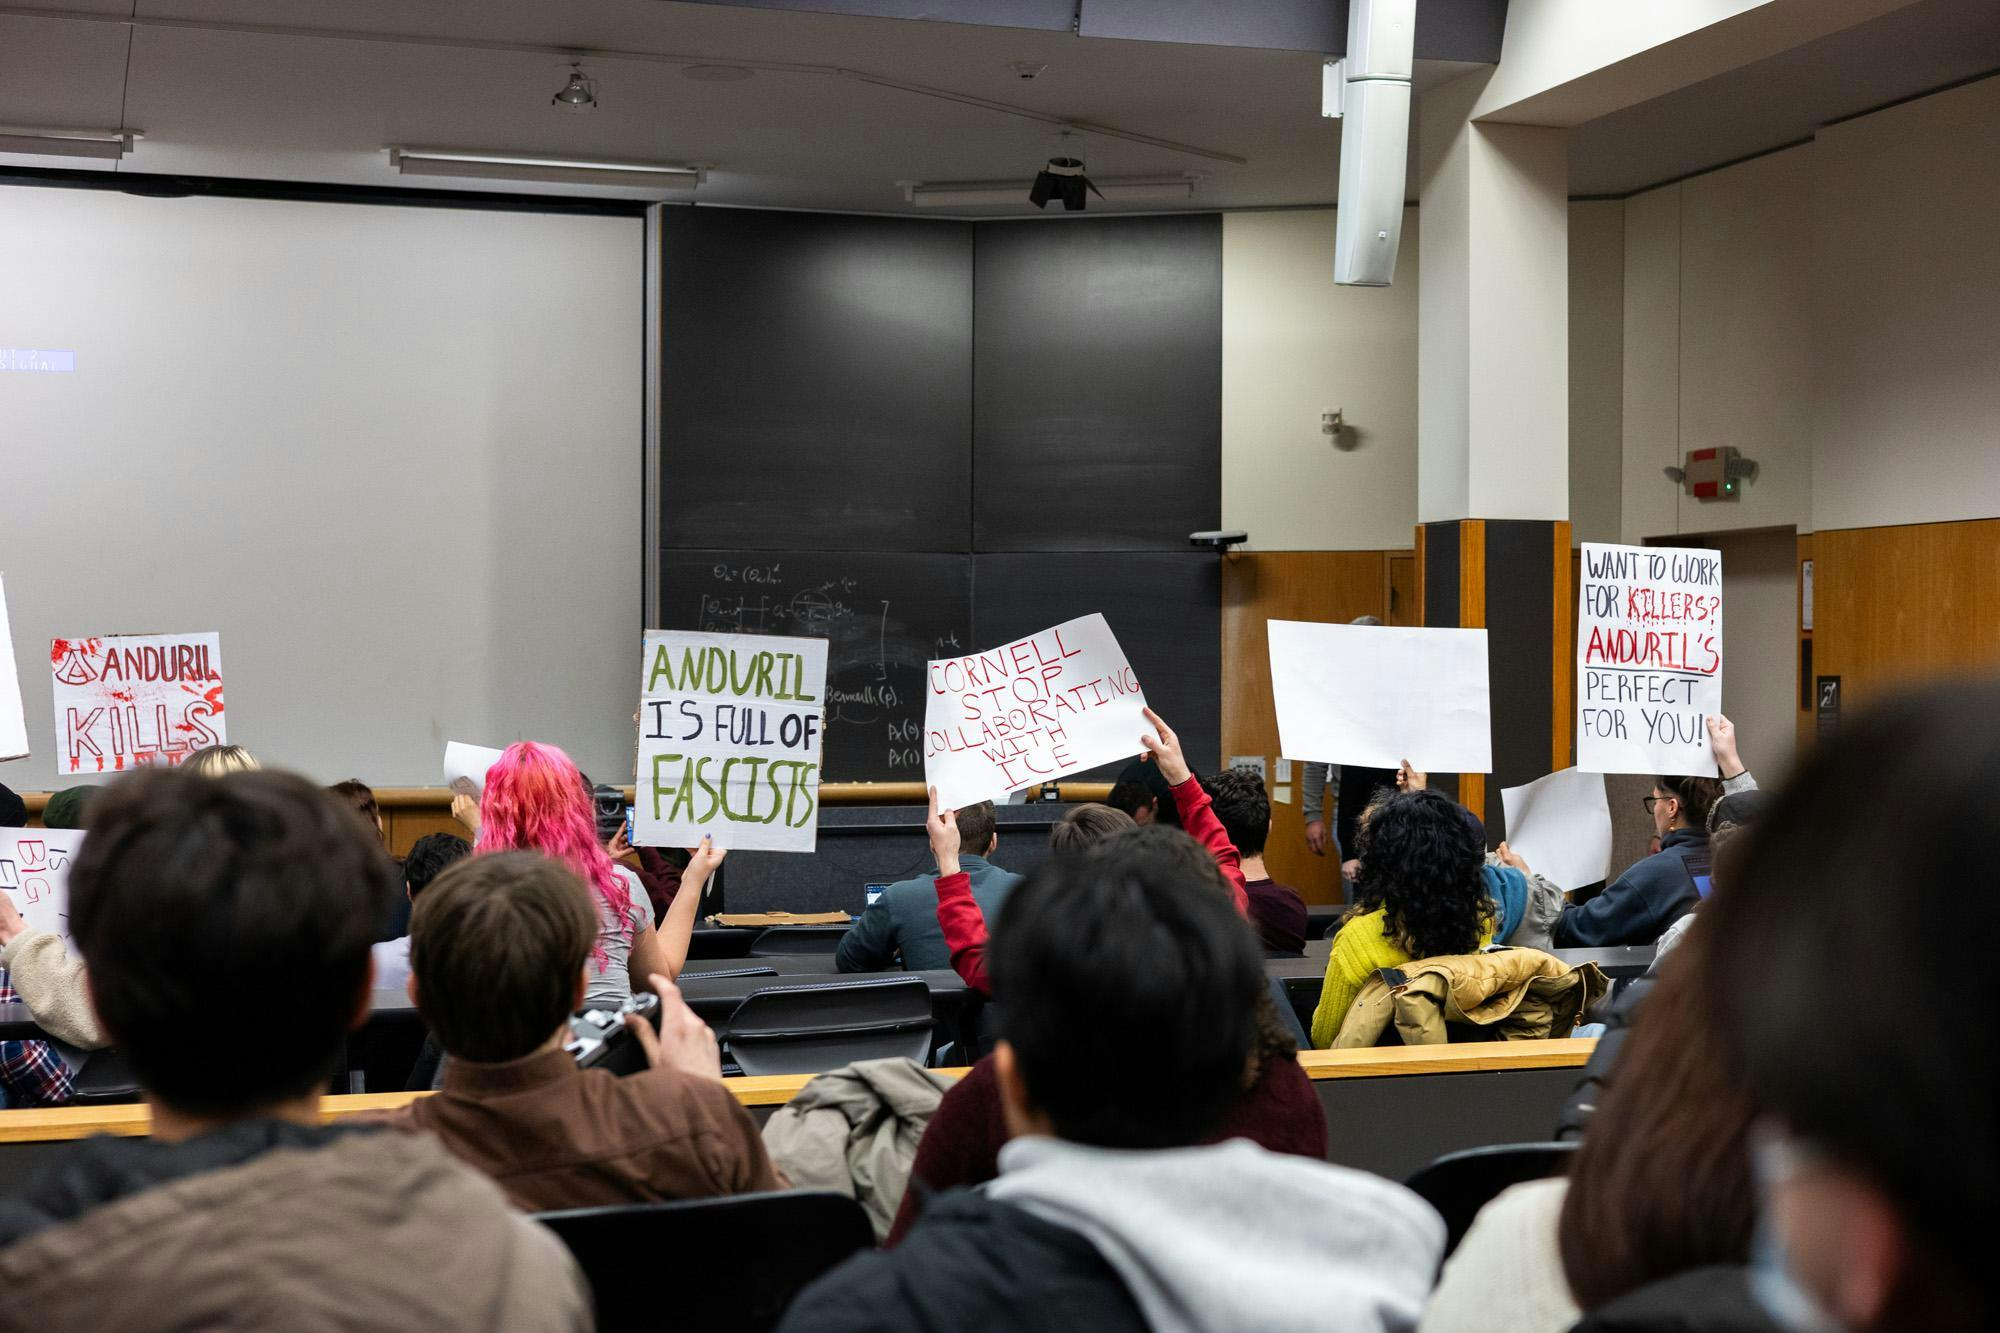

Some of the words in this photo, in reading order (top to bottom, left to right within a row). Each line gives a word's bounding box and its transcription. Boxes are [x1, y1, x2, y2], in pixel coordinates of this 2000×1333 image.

[1587, 549, 1640, 580] WANT
[1644, 554, 1666, 581] TO
[1672, 554, 1719, 586] WORK
[1585, 584, 1620, 618] FOR
[1627, 585, 1720, 628] KILLERS?
[100, 644, 219, 682] ANDURIL
[648, 644, 816, 702] ANDURIL
[931, 630, 1081, 695] CORNELL
[1586, 625, 1719, 674] ANDURIL'S
[962, 666, 1063, 720] STOP
[1586, 671, 1699, 706] PERFECT
[67, 700, 219, 759] KILLS
[645, 700, 704, 741] IS
[716, 704, 775, 746] FULL
[780, 713, 819, 750] OF
[982, 721, 1067, 763] WITH
[1583, 708, 1627, 740] FOR
[1641, 708, 1703, 747] YOU!
[652, 754, 817, 828] FASCISTS
[996, 744, 1078, 790] ICE
[17, 840, 51, 905] BIG
